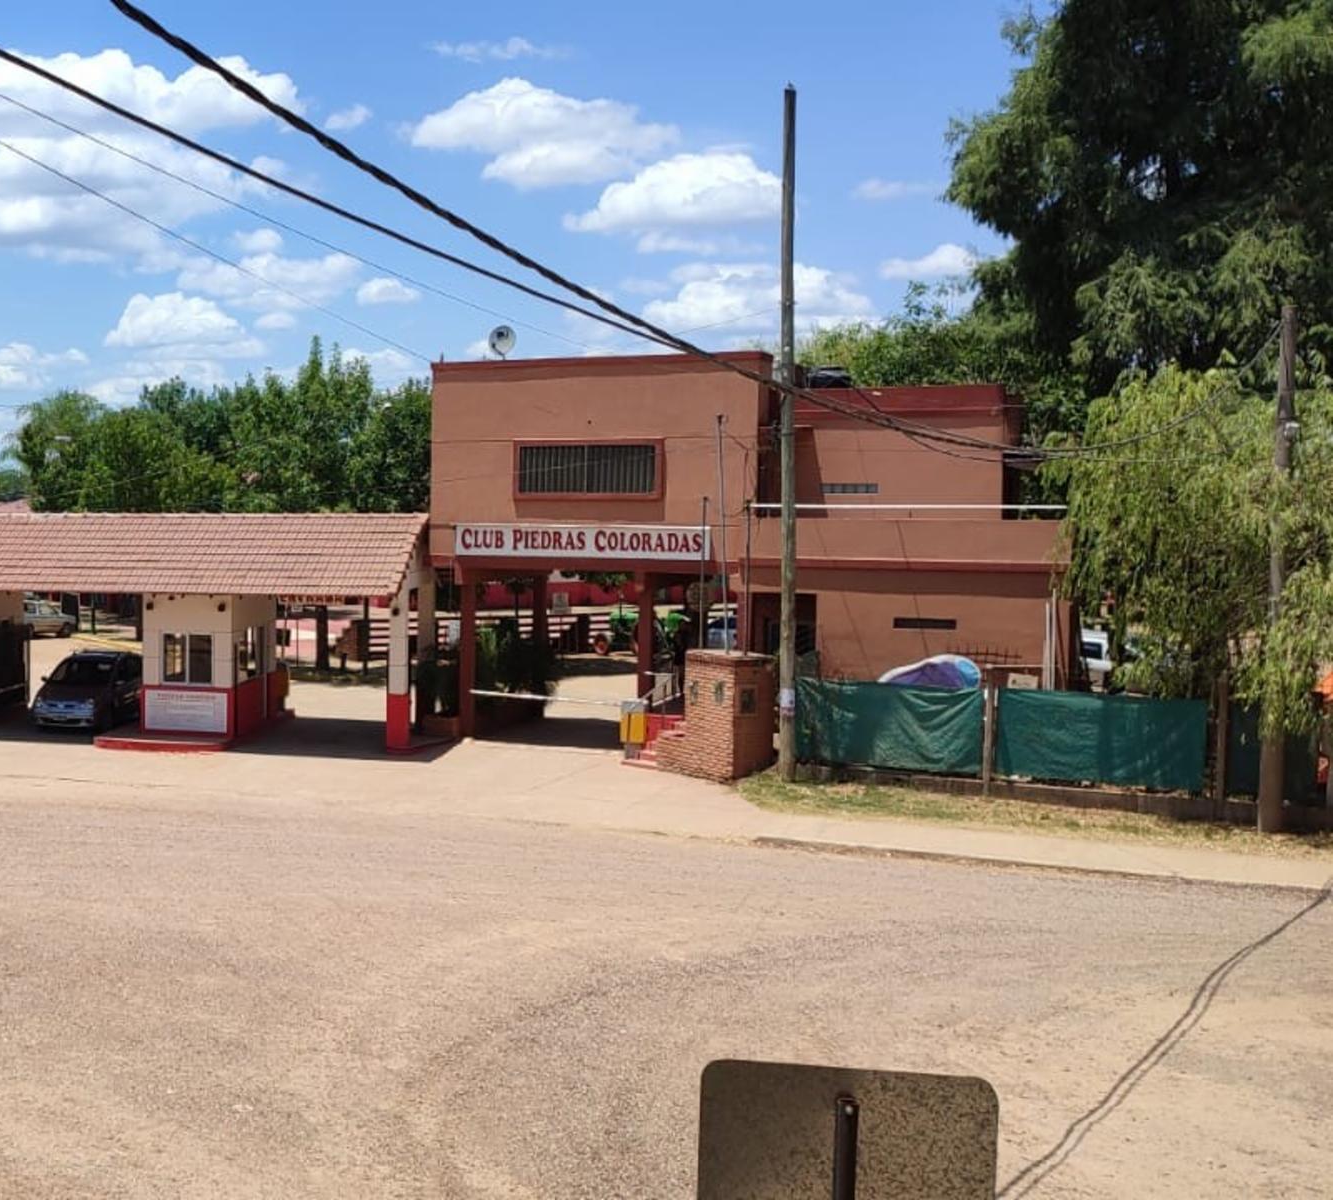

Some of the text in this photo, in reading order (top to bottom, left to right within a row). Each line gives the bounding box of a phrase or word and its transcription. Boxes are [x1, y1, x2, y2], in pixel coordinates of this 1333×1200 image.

[461, 528, 703, 553] CLUB PIEDRAS COLORADAS
